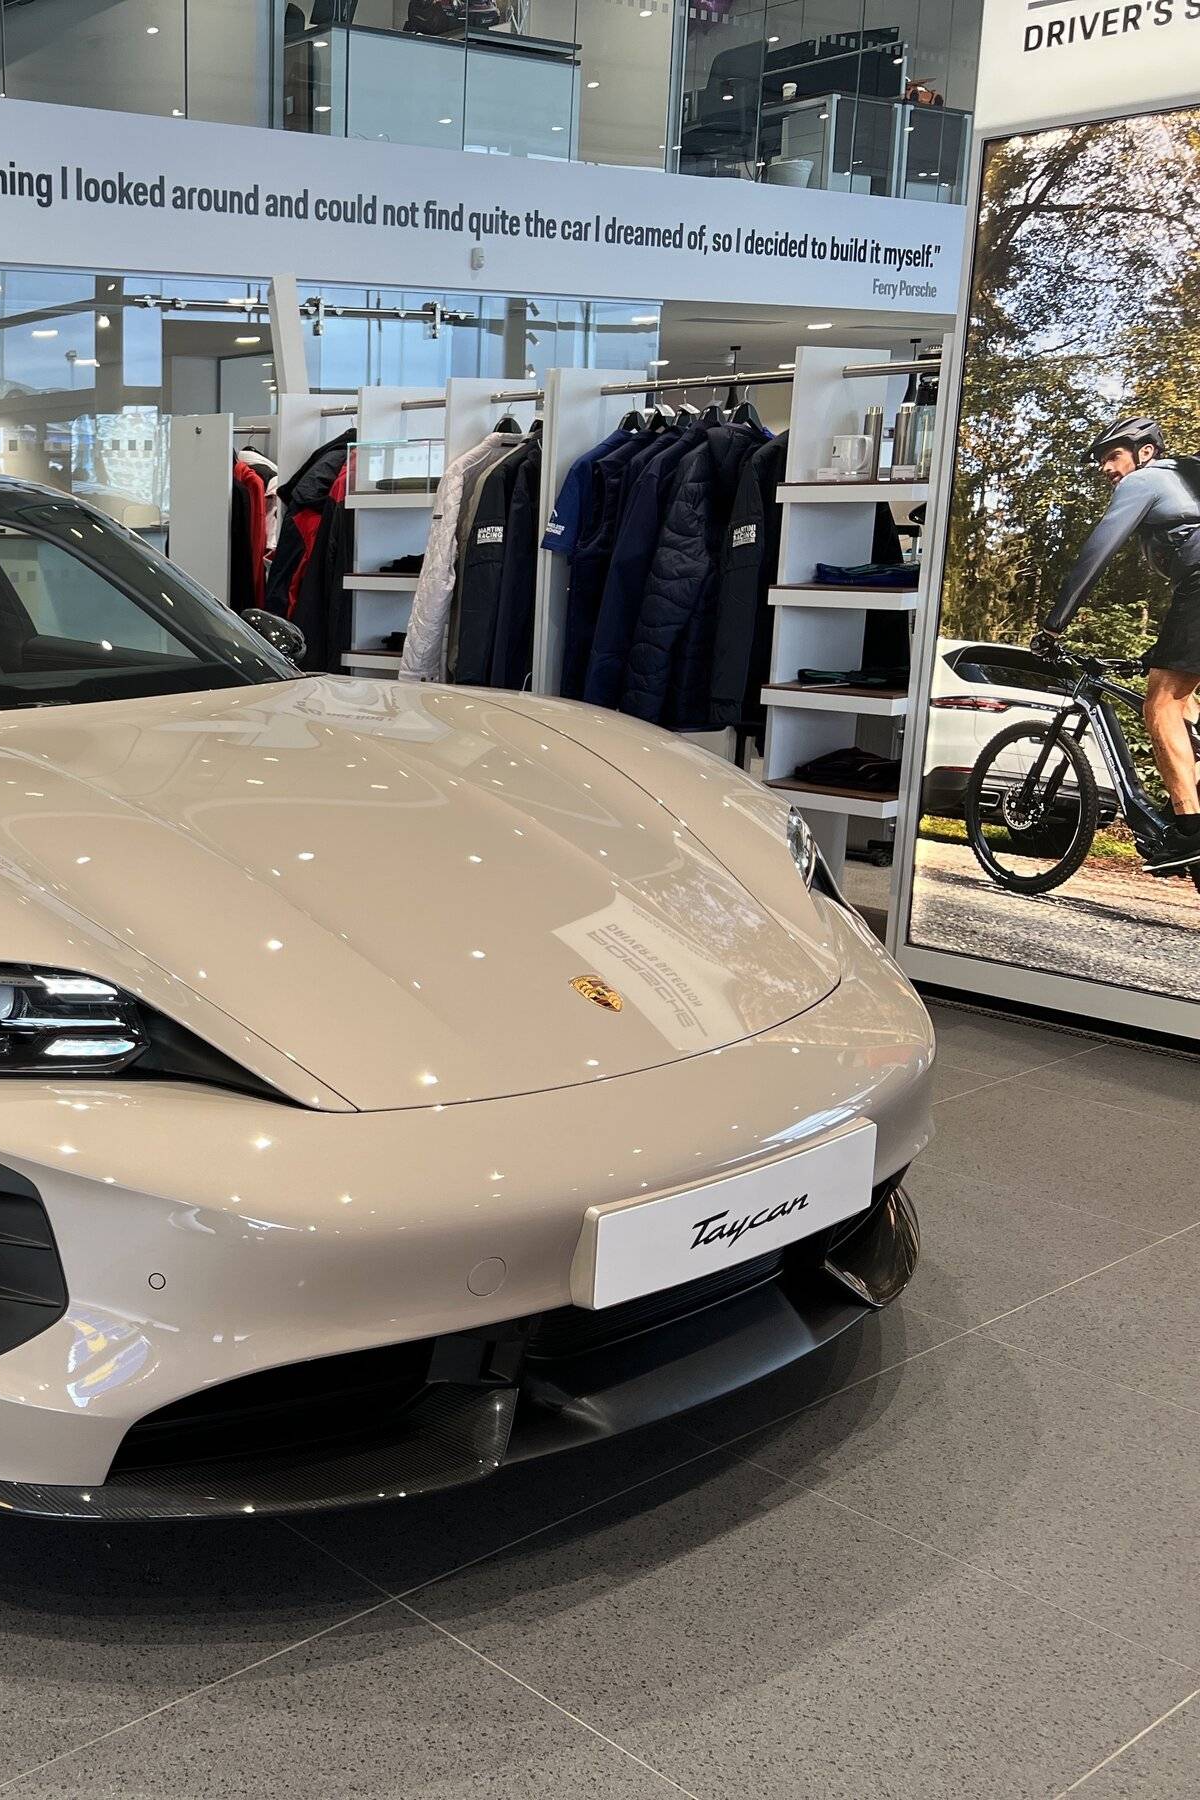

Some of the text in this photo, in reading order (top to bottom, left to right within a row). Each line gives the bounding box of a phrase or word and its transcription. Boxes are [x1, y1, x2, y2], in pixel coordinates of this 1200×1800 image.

[1024, 0, 1173, 51] DRIVER'S
[61, 166, 68, 200] I
[76, 167, 165, 208] looked
[172, 184, 259, 215] around
[264, 189, 308, 220] and
[312, 194, 377, 224] could
[383, 200, 419, 229] not
[422, 200, 464, 231] find
[468, 206, 520, 241] quite
[524, 210, 558, 239] the
[560, 220, 591, 241] car
[595, 215, 600, 242] I
[604, 217, 684, 249] dreamed
[687, 225, 708, 255] of,
[712, 233, 732, 252] so
[736, 228, 741, 253] I
[744, 229, 808, 258] decided
[811, 237, 827, 260] to
[830, 236, 868, 263] build
[870, 239, 881, 264] it
[872, 278, 937, 299] Ferry Porsche
[477, 532, 503, 540] RACING
[478, 526, 504, 534] MARTINI
[1096, 723, 1121, 784] PORSCHE
[690, 1193, 809, 1250] Taycan
